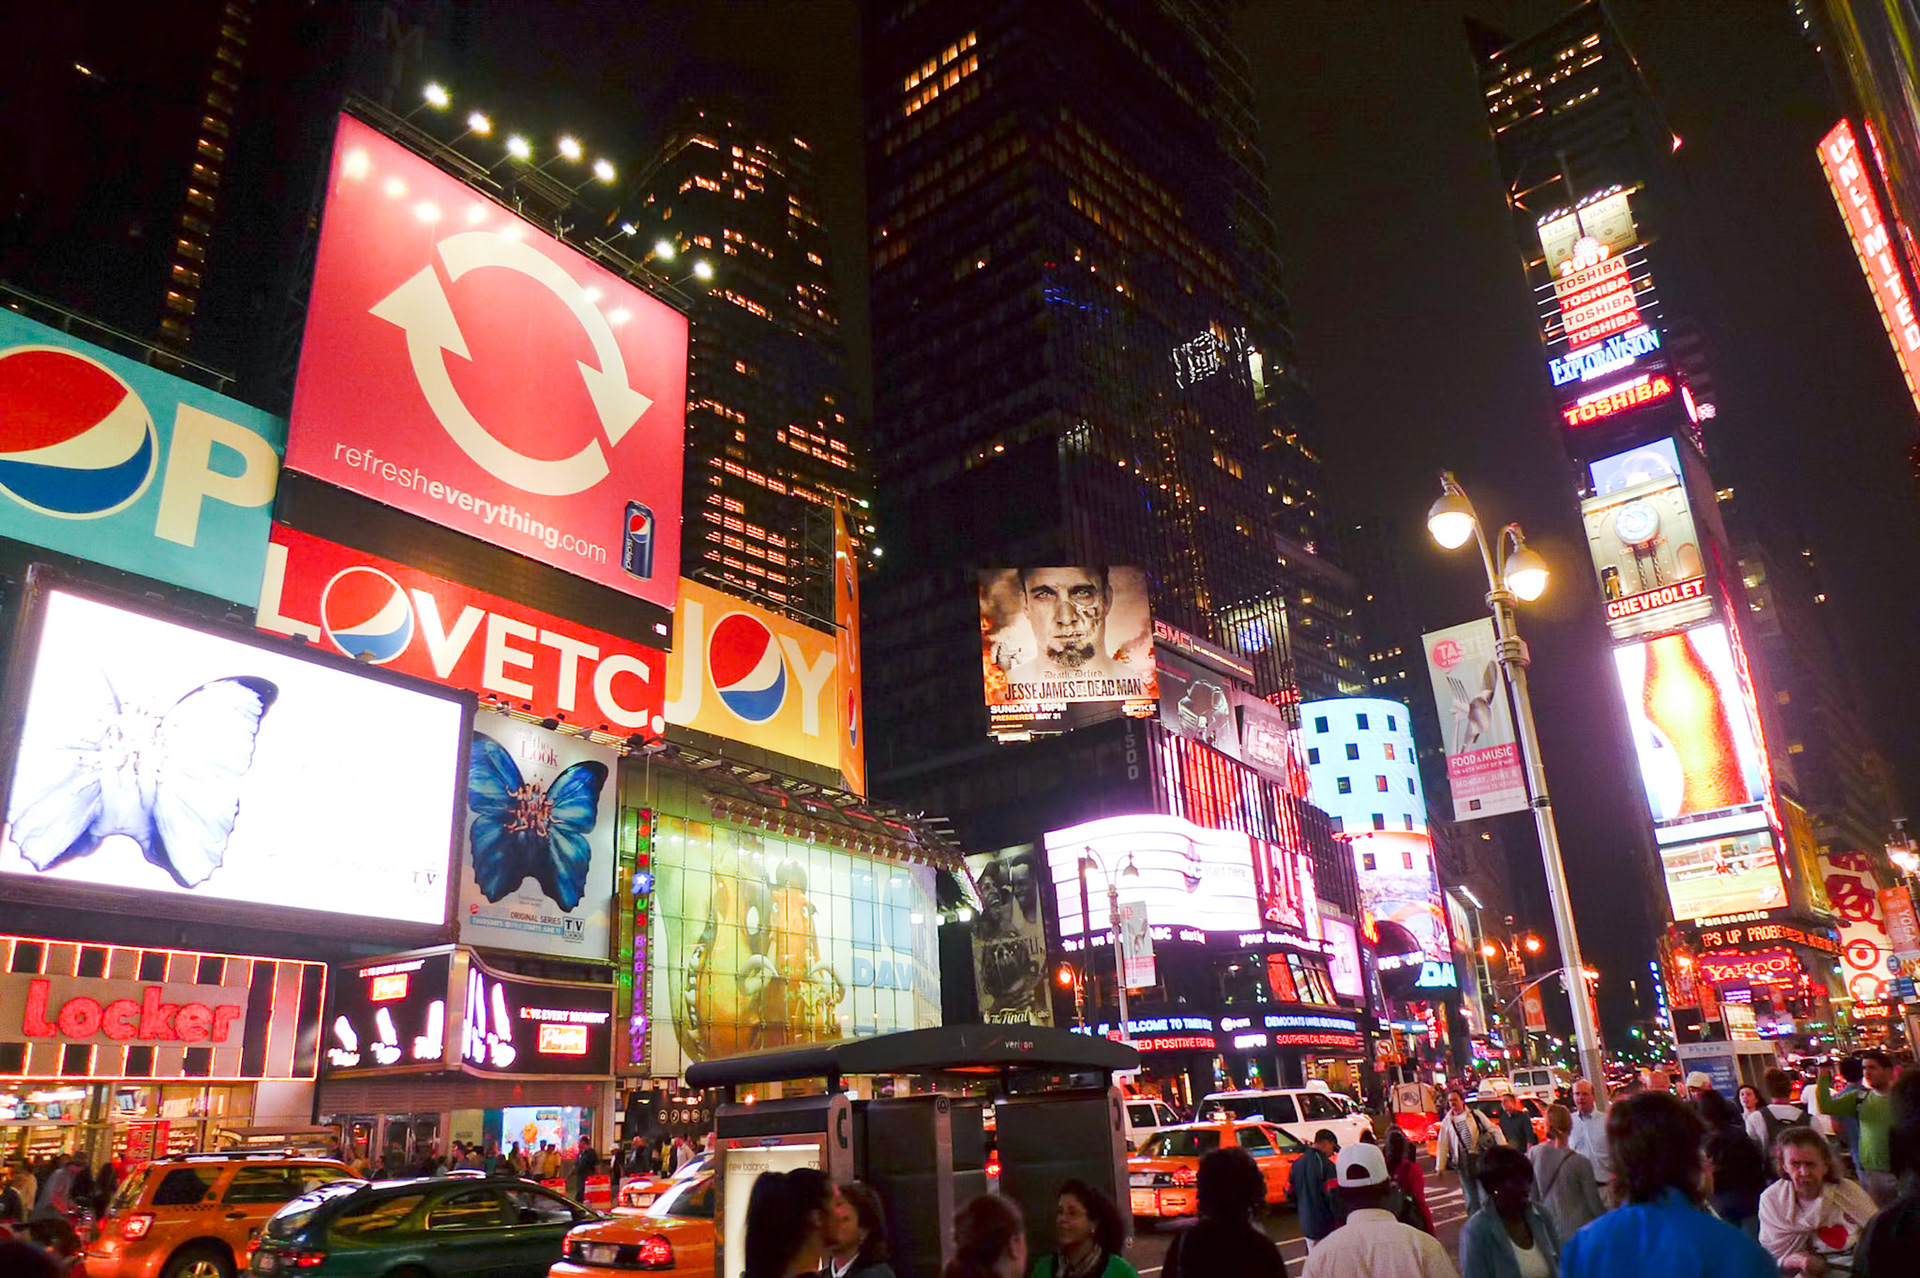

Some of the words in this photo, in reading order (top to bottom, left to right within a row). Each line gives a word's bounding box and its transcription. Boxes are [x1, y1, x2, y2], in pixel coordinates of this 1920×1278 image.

[1829, 135, 1920, 350] UNLIMITED
[1556, 260, 1623, 292] TOSHIBA
[1560, 276, 1629, 310] TOSHIBA
[1565, 295, 1633, 327] TOSHIBA
[1569, 311, 1640, 344] TOSHIBA
[1563, 377, 1672, 426] TOSHIBA
[333, 442, 607, 565] refresheverything.com
[1607, 580, 1703, 618] CHEVROLET
[1154, 620, 1192, 648] GMC
[1005, 682, 1038, 700] JESSE
[1039, 680, 1075, 699] JAMES
[1088, 679, 1115, 698] DEAD
[1117, 678, 1142, 697] MAN
[990, 703, 1039, 714] SUNDAYS
[1040, 702, 1068, 712] 10PM
[991, 714, 1035, 722] PREMIERES
[1121, 704, 1158, 712] SPIKE
[520, 740, 559, 768] Look
[1451, 754, 1476, 768] FOOD
[1482, 746, 1514, 761] MUSIC
[510, 911, 538, 923] ORIGINAL
[540, 915, 562, 925] SERIES
[564, 919, 583, 932] TV
[1694, 910, 1770, 928] Panasonic
[1898, 908, 1918, 943] YOGA
[1725, 929, 1743, 944] UP
[1701, 956, 1791, 982] YAHOO!
[22, 978, 241, 1042] Locker
[541, 1009, 568, 1021] EVERY
[1169, 1018, 1183, 1031] TO
[1154, 1037, 1195, 1050] POSITIVE
[728, 1163, 742, 1171] new
[742, 1161, 769, 1171] balance
